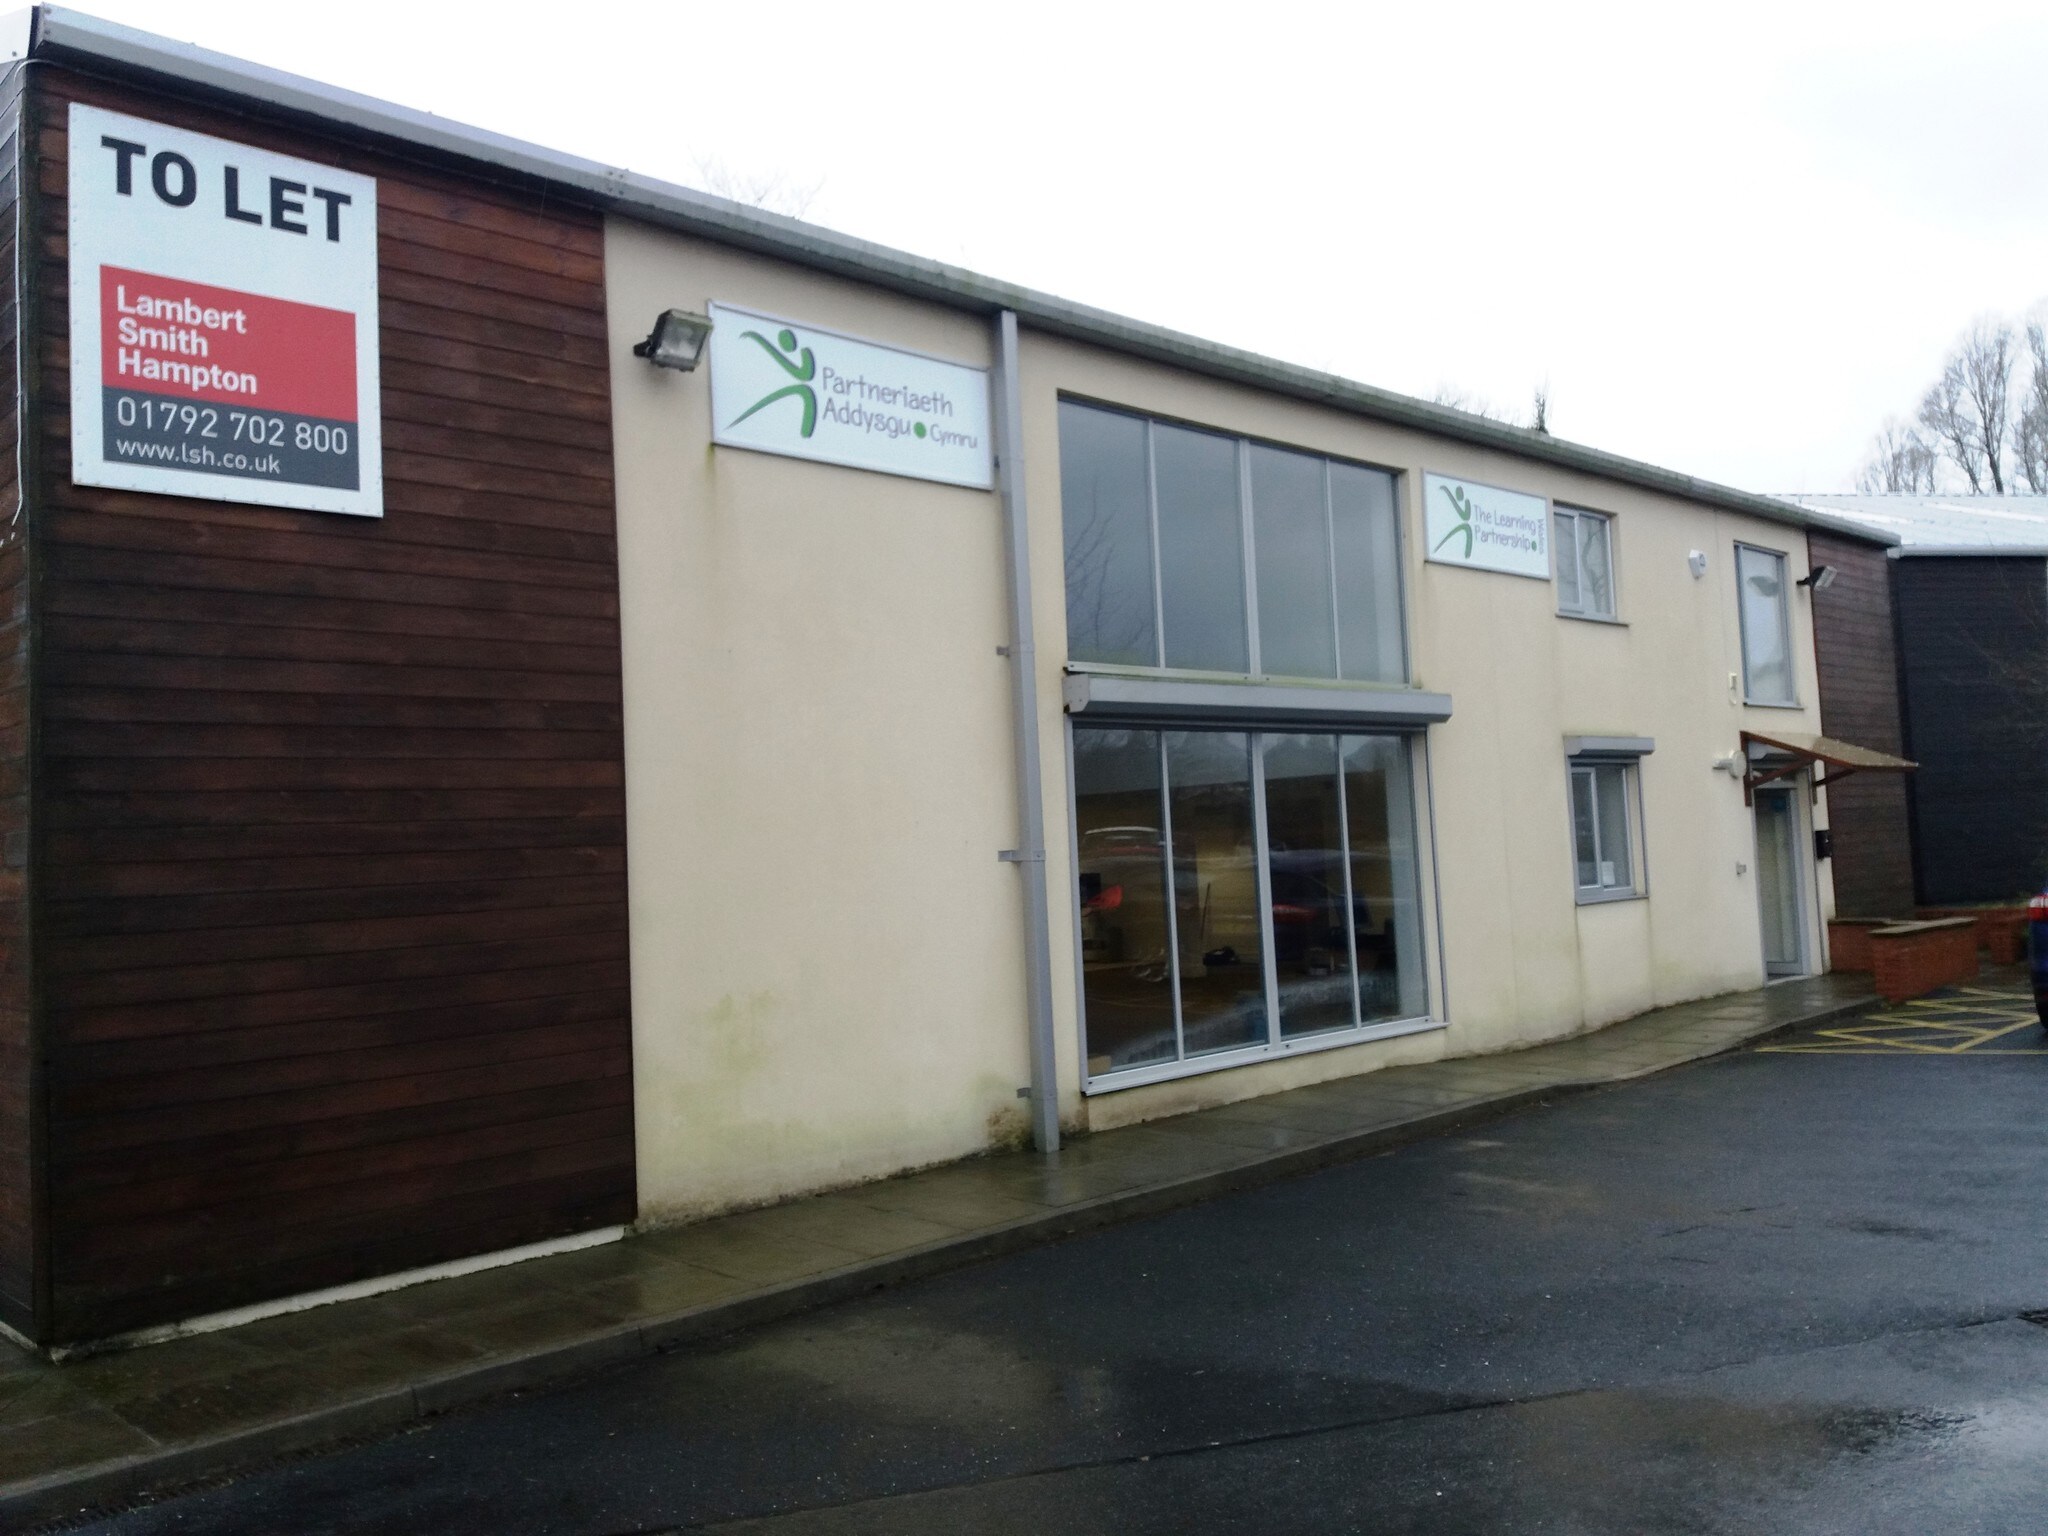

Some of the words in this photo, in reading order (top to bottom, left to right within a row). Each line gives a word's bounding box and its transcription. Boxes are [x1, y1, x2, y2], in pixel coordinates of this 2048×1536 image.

[101, 135, 198, 208] TO
[224, 165, 351, 243] LET
[117, 285, 247, 334] Lambert
[117, 318, 208, 357] Smith
[117, 347, 258, 395] Hampton
[822, 367, 953, 417] Partneriaeth
[117, 397, 218, 438] 01792
[229, 412, 285, 447] 702
[295, 422, 348, 455] 800
[822, 398, 911, 439] Addysgu
[930, 423, 978, 449] Cymru
[116, 439, 280, 474] www.lsh.co.uk
[1474, 504, 1492, 524] The
[1494, 510, 1536, 536] Learning
[1474, 525, 1531, 553] Partnership
